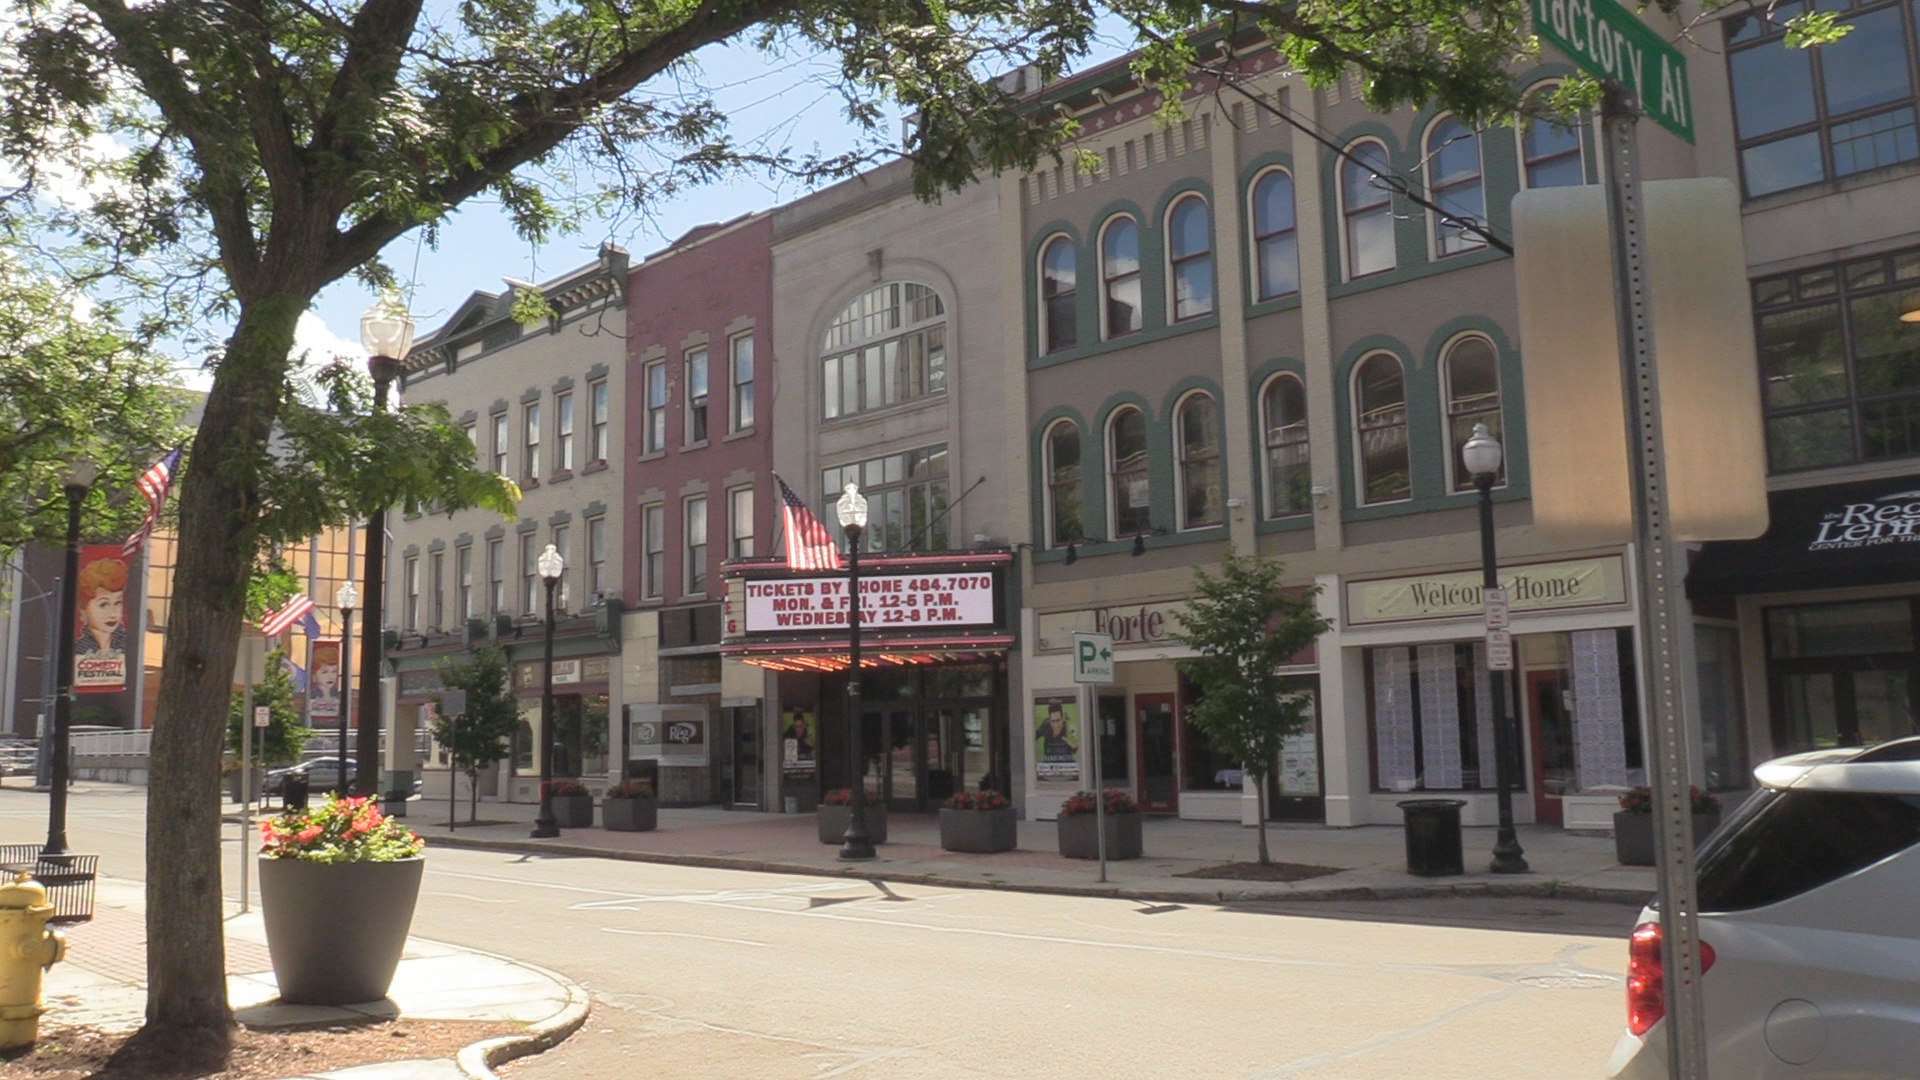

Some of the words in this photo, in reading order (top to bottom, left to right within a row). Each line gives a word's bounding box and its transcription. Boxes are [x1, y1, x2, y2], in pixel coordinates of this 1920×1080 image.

[1661, 54, 1687, 127] Al
[1808, 541, 1863, 551] CENTER
[747, 583, 814, 598] TICKETS
[820, 581, 842, 595] BY
[908, 576, 991, 592] 484.7070
[1411, 583, 1506, 607] Welco
[1515, 575, 1581, 600] Home
[773, 597, 815, 611] MON.
[821, 597, 834, 610] &
[839, 595, 873, 609] FI.
[879, 595, 918, 608] 12-5
[923, 593, 959, 606] P.M.
[882, 609, 921, 623] 12-8
[927, 608, 963, 621] P.M.
[1094, 606, 1165, 641] Forte
[78, 660, 123, 670] COMEDY
